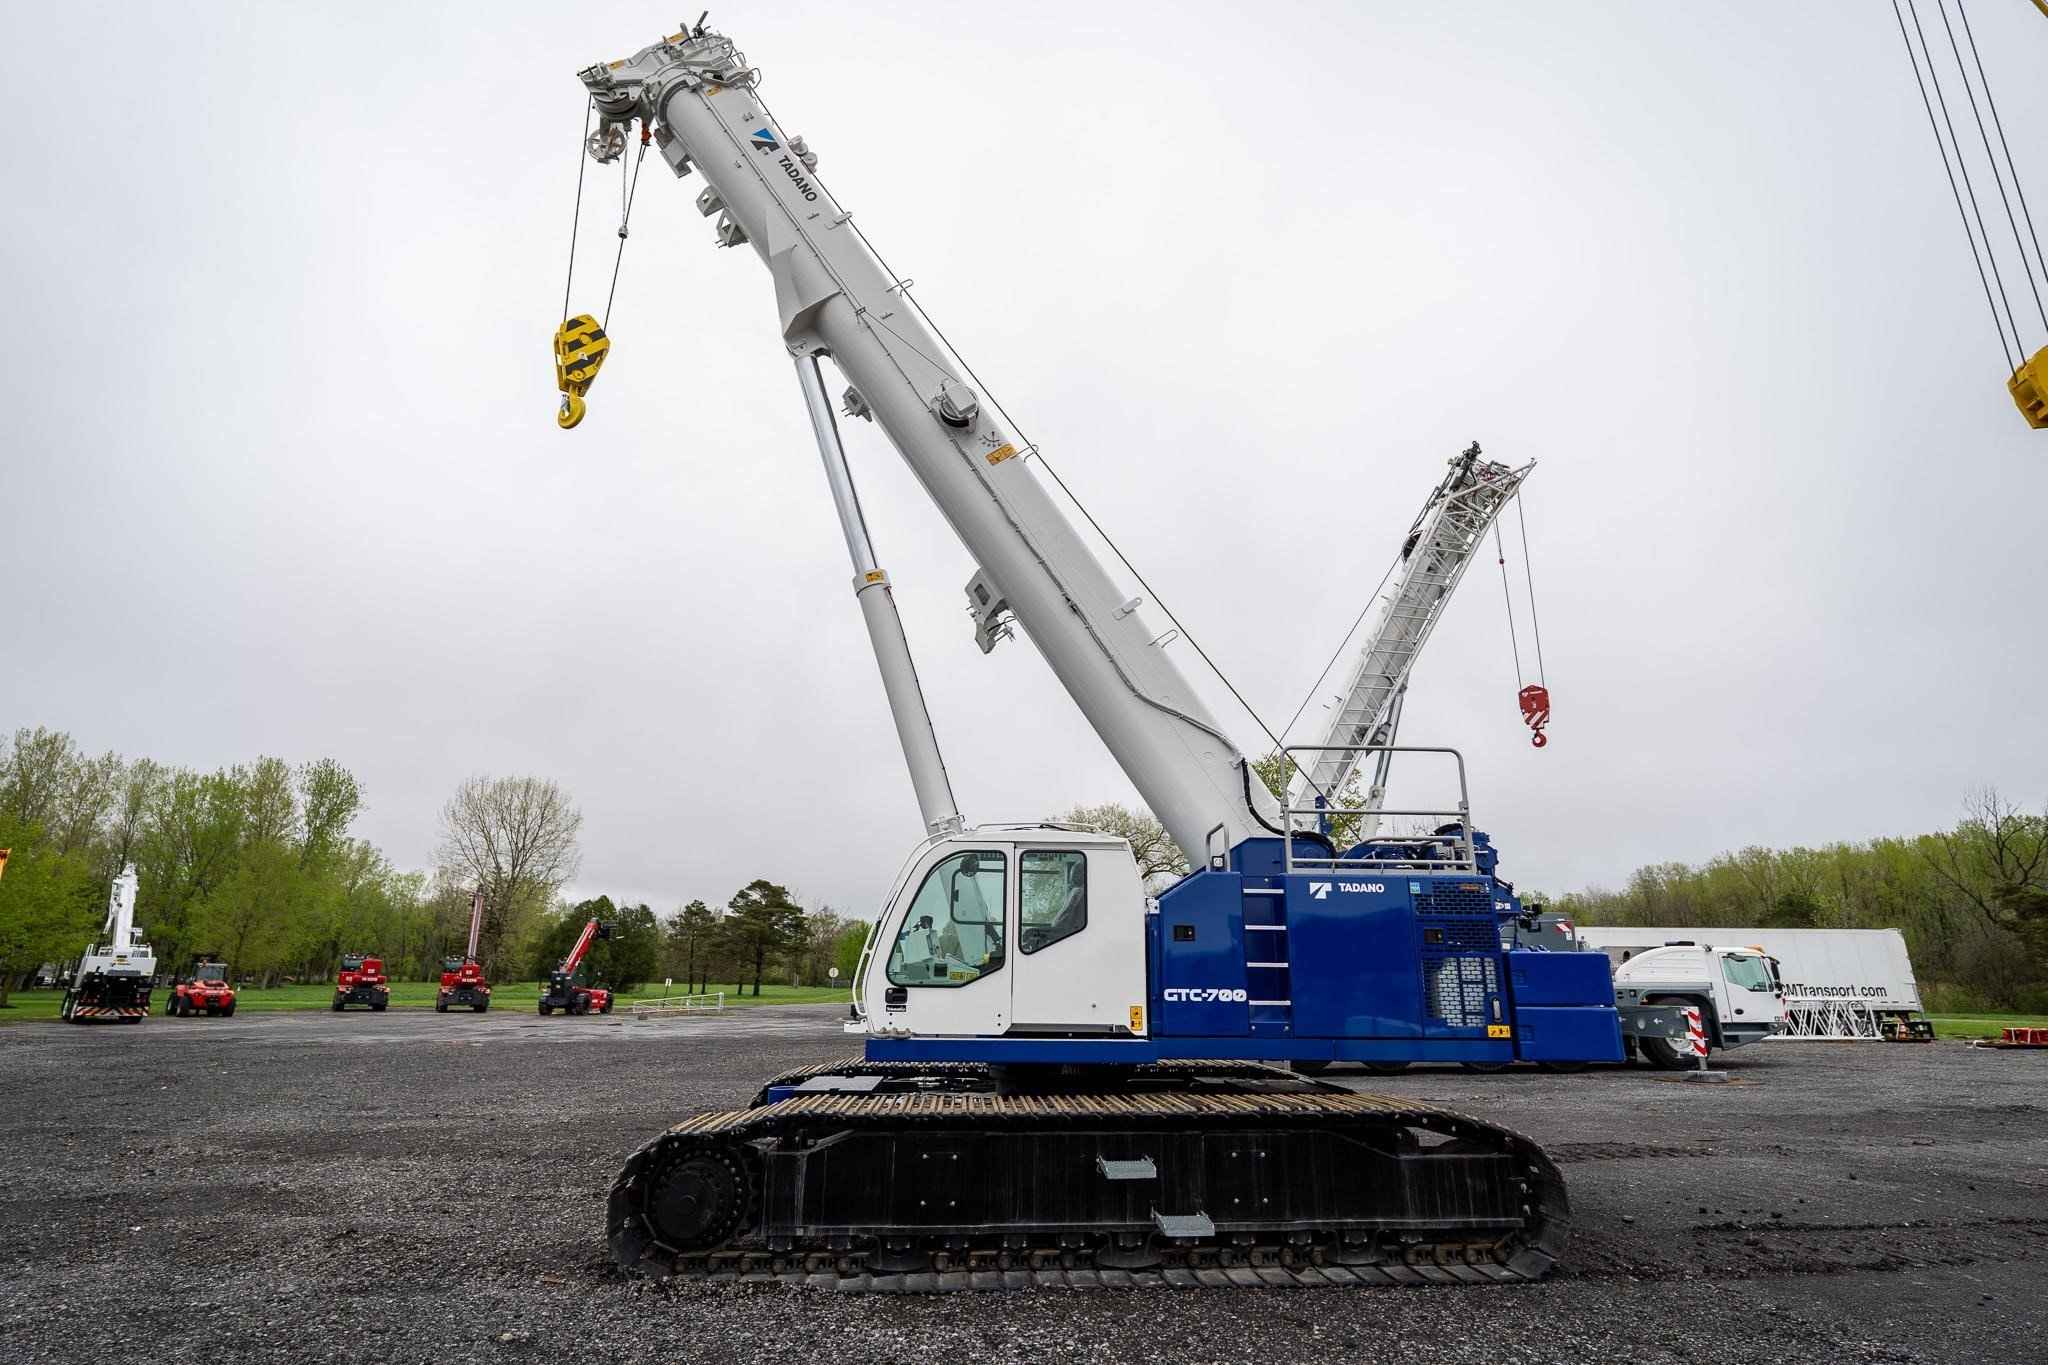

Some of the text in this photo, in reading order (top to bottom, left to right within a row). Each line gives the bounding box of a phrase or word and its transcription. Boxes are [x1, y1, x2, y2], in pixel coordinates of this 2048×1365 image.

[779, 155, 818, 202] TADANO
[1338, 882, 1385, 894] TADANO
[1163, 988, 1248, 1002] GTC-700
